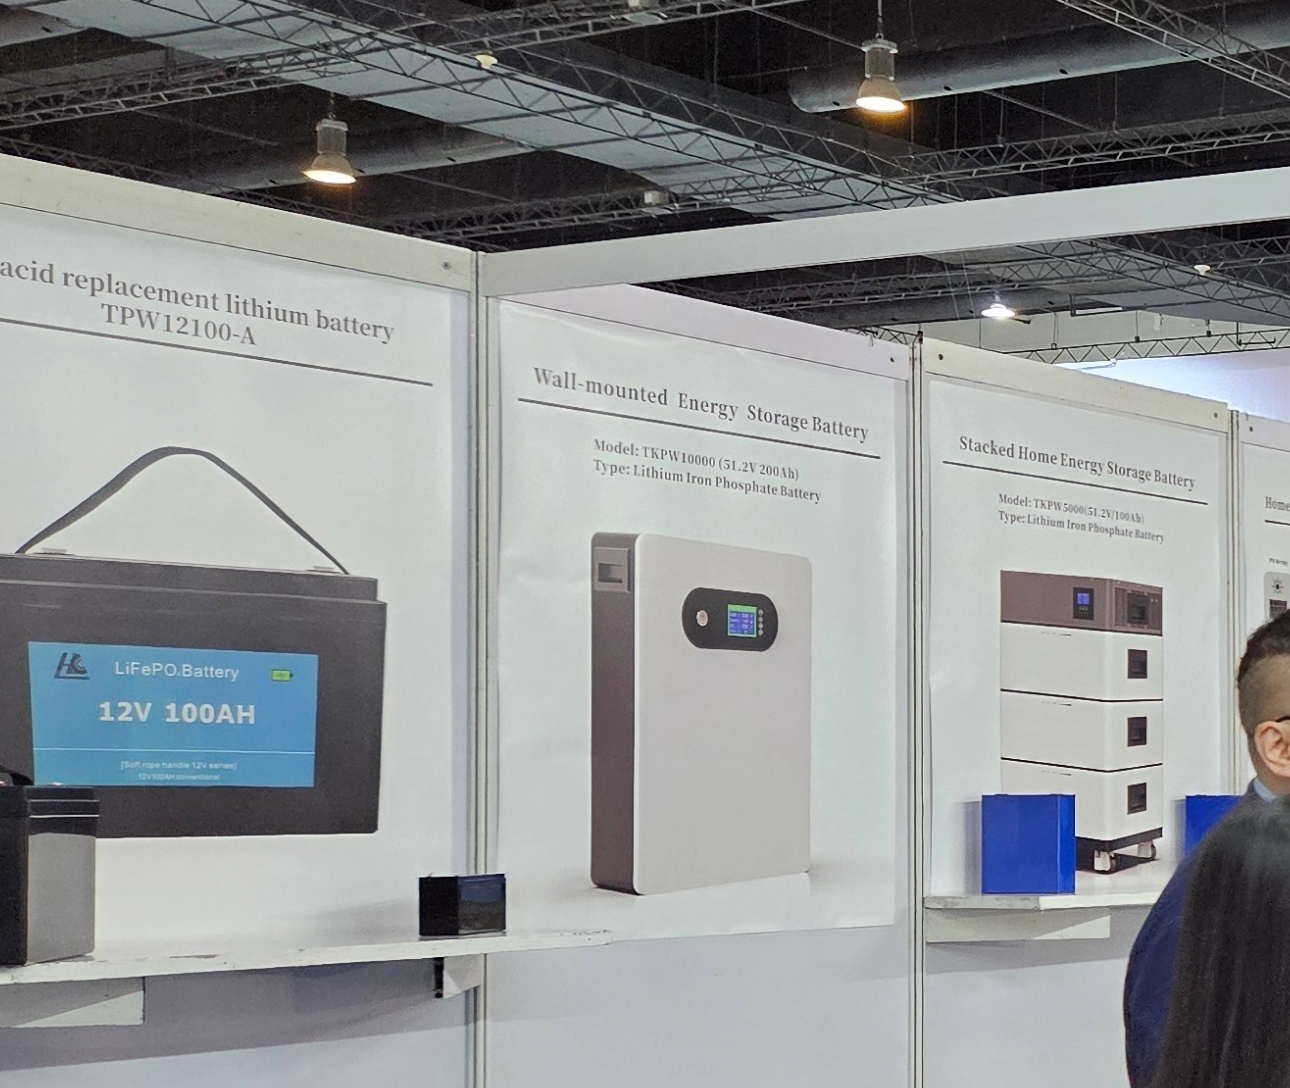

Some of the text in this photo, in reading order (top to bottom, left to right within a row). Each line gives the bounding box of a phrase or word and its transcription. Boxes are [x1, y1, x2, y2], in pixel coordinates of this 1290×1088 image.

[0, 260, 394, 345] acid replacement lithium battery
[101, 302, 257, 347] TPW12100-A
[534, 367, 869, 444] Wall-mounted Energy Storage Battery
[594, 438, 640, 458] Model:
[642, 446, 716, 468] TKPW10000
[718, 456, 757, 474] (51.2V
[959, 435, 1196, 492] Stacked Home Energy Storage Battery
[593, 458, 822, 504] Type: Lithium Iron Phosphate Battery
[998, 493, 1032, 508] Model:
[998, 510, 1165, 544] Type: Lithium Iron Phosphate Battery
[99, 701, 256, 725] 12V 100AH
